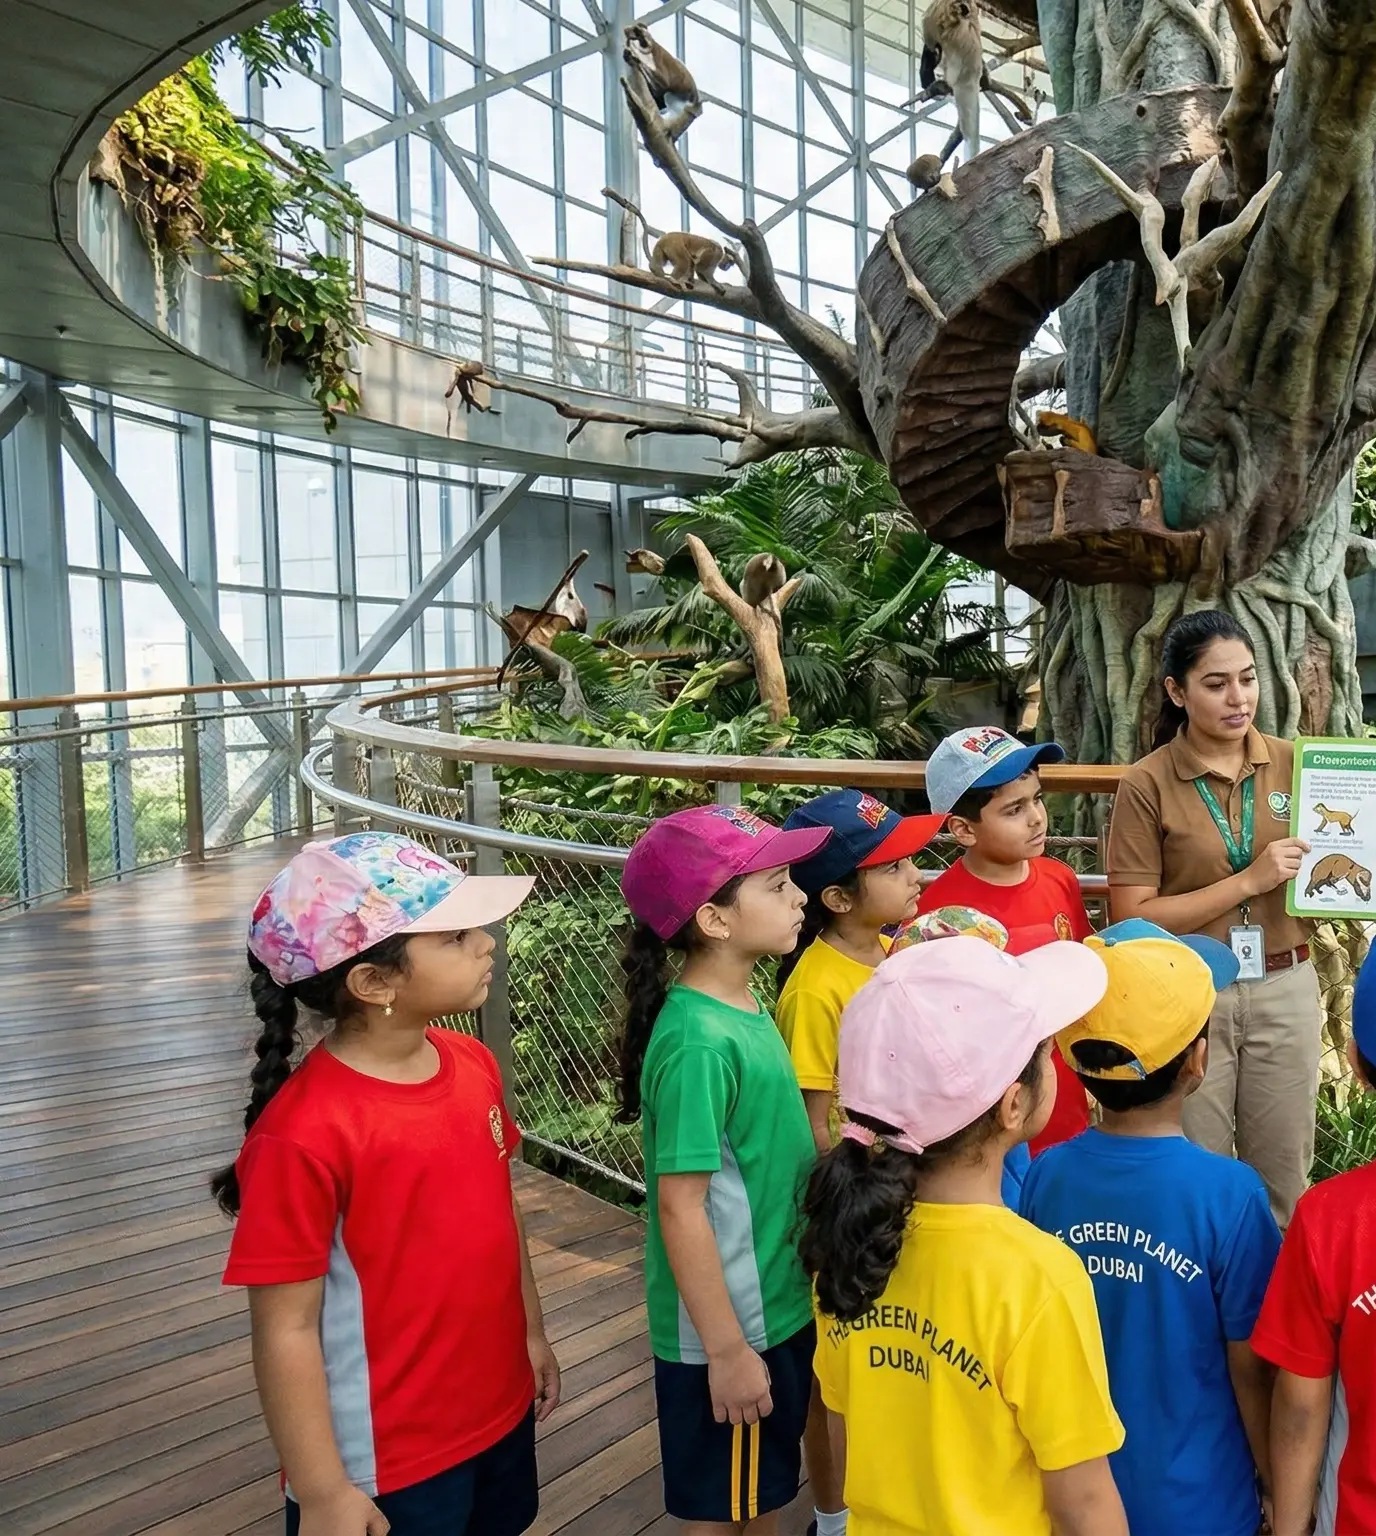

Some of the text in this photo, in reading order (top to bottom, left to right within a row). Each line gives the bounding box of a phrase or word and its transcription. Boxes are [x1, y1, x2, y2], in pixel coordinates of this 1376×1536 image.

[1069, 1222, 1203, 1283] GREEN PLANET
[1087, 1255, 1144, 1283] DUBAI
[851, 1305, 918, 1333] GREEN
[921, 1318, 992, 1391] PLANET
[869, 1346, 930, 1383] DUBAI
